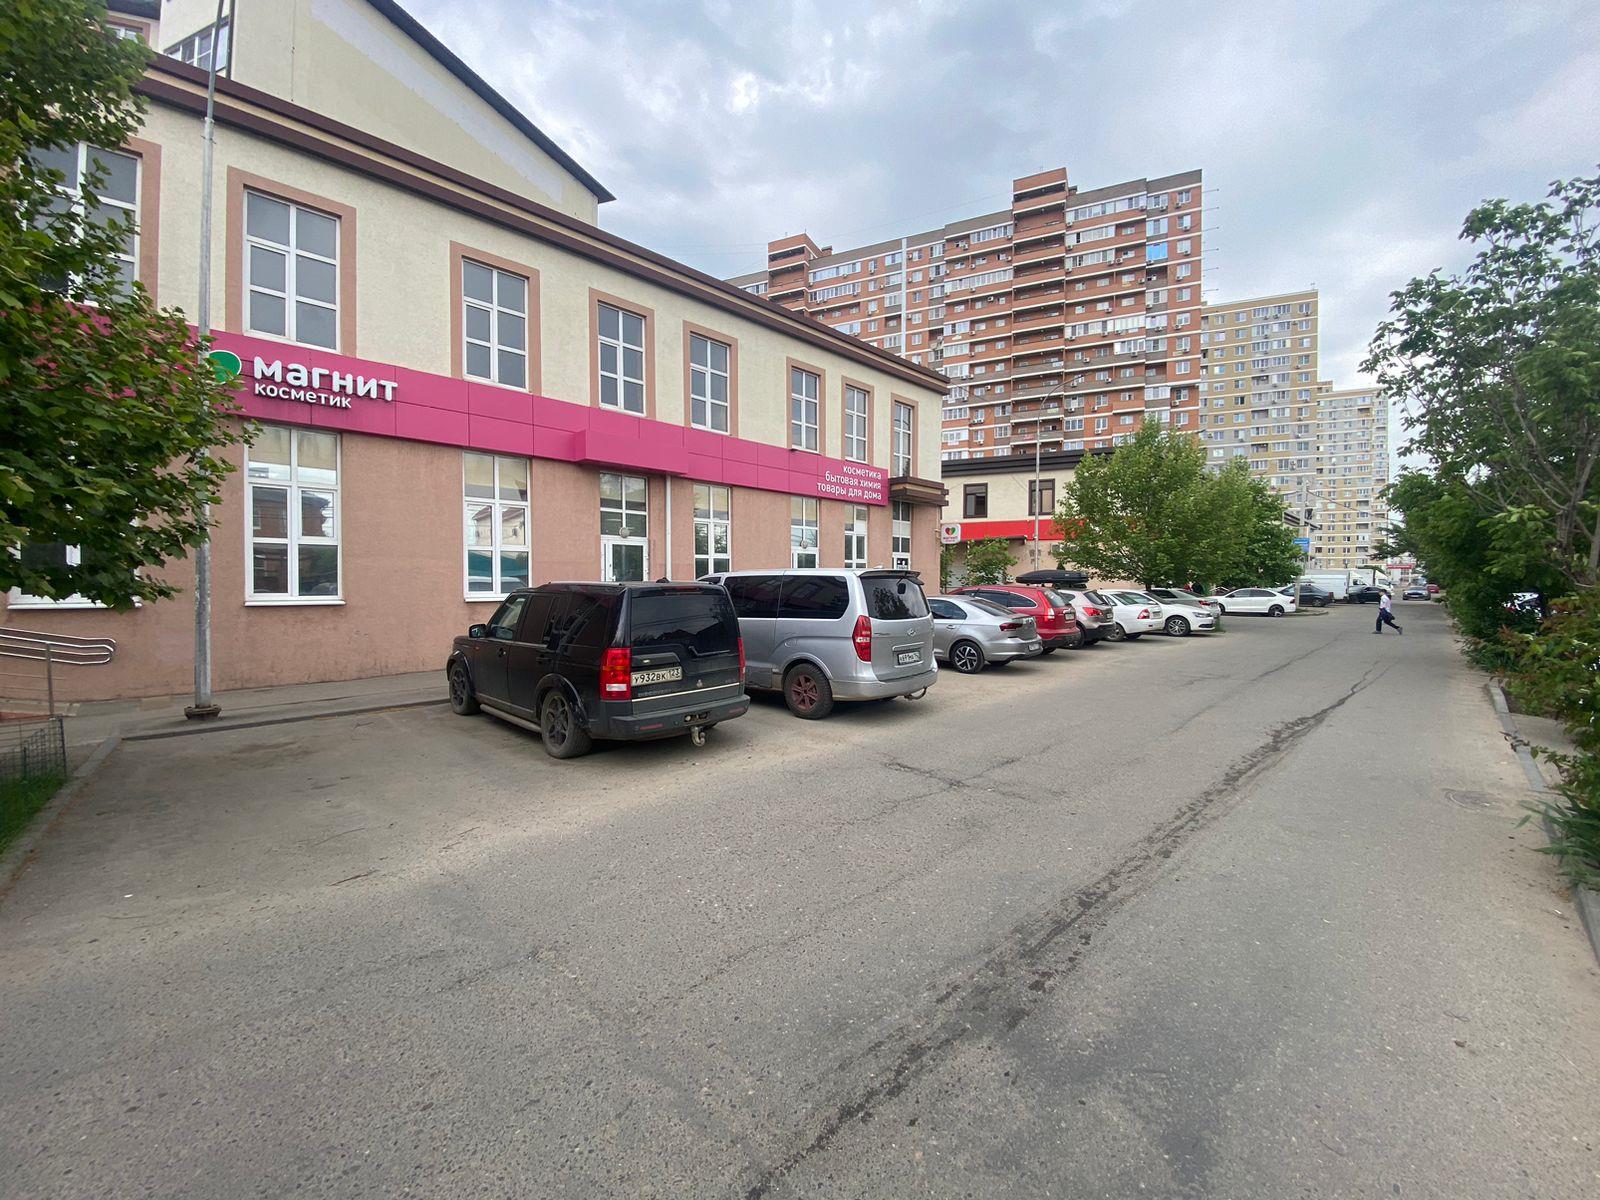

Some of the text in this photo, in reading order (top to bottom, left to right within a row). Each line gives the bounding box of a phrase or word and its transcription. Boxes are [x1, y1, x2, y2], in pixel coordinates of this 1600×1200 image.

[253, 356, 399, 402] магнит
[254, 383, 352, 409] косметик
[825, 471, 881, 490] бытовая химия
[843, 466, 881, 479] косметика
[817, 483, 881, 500] товары для дома
